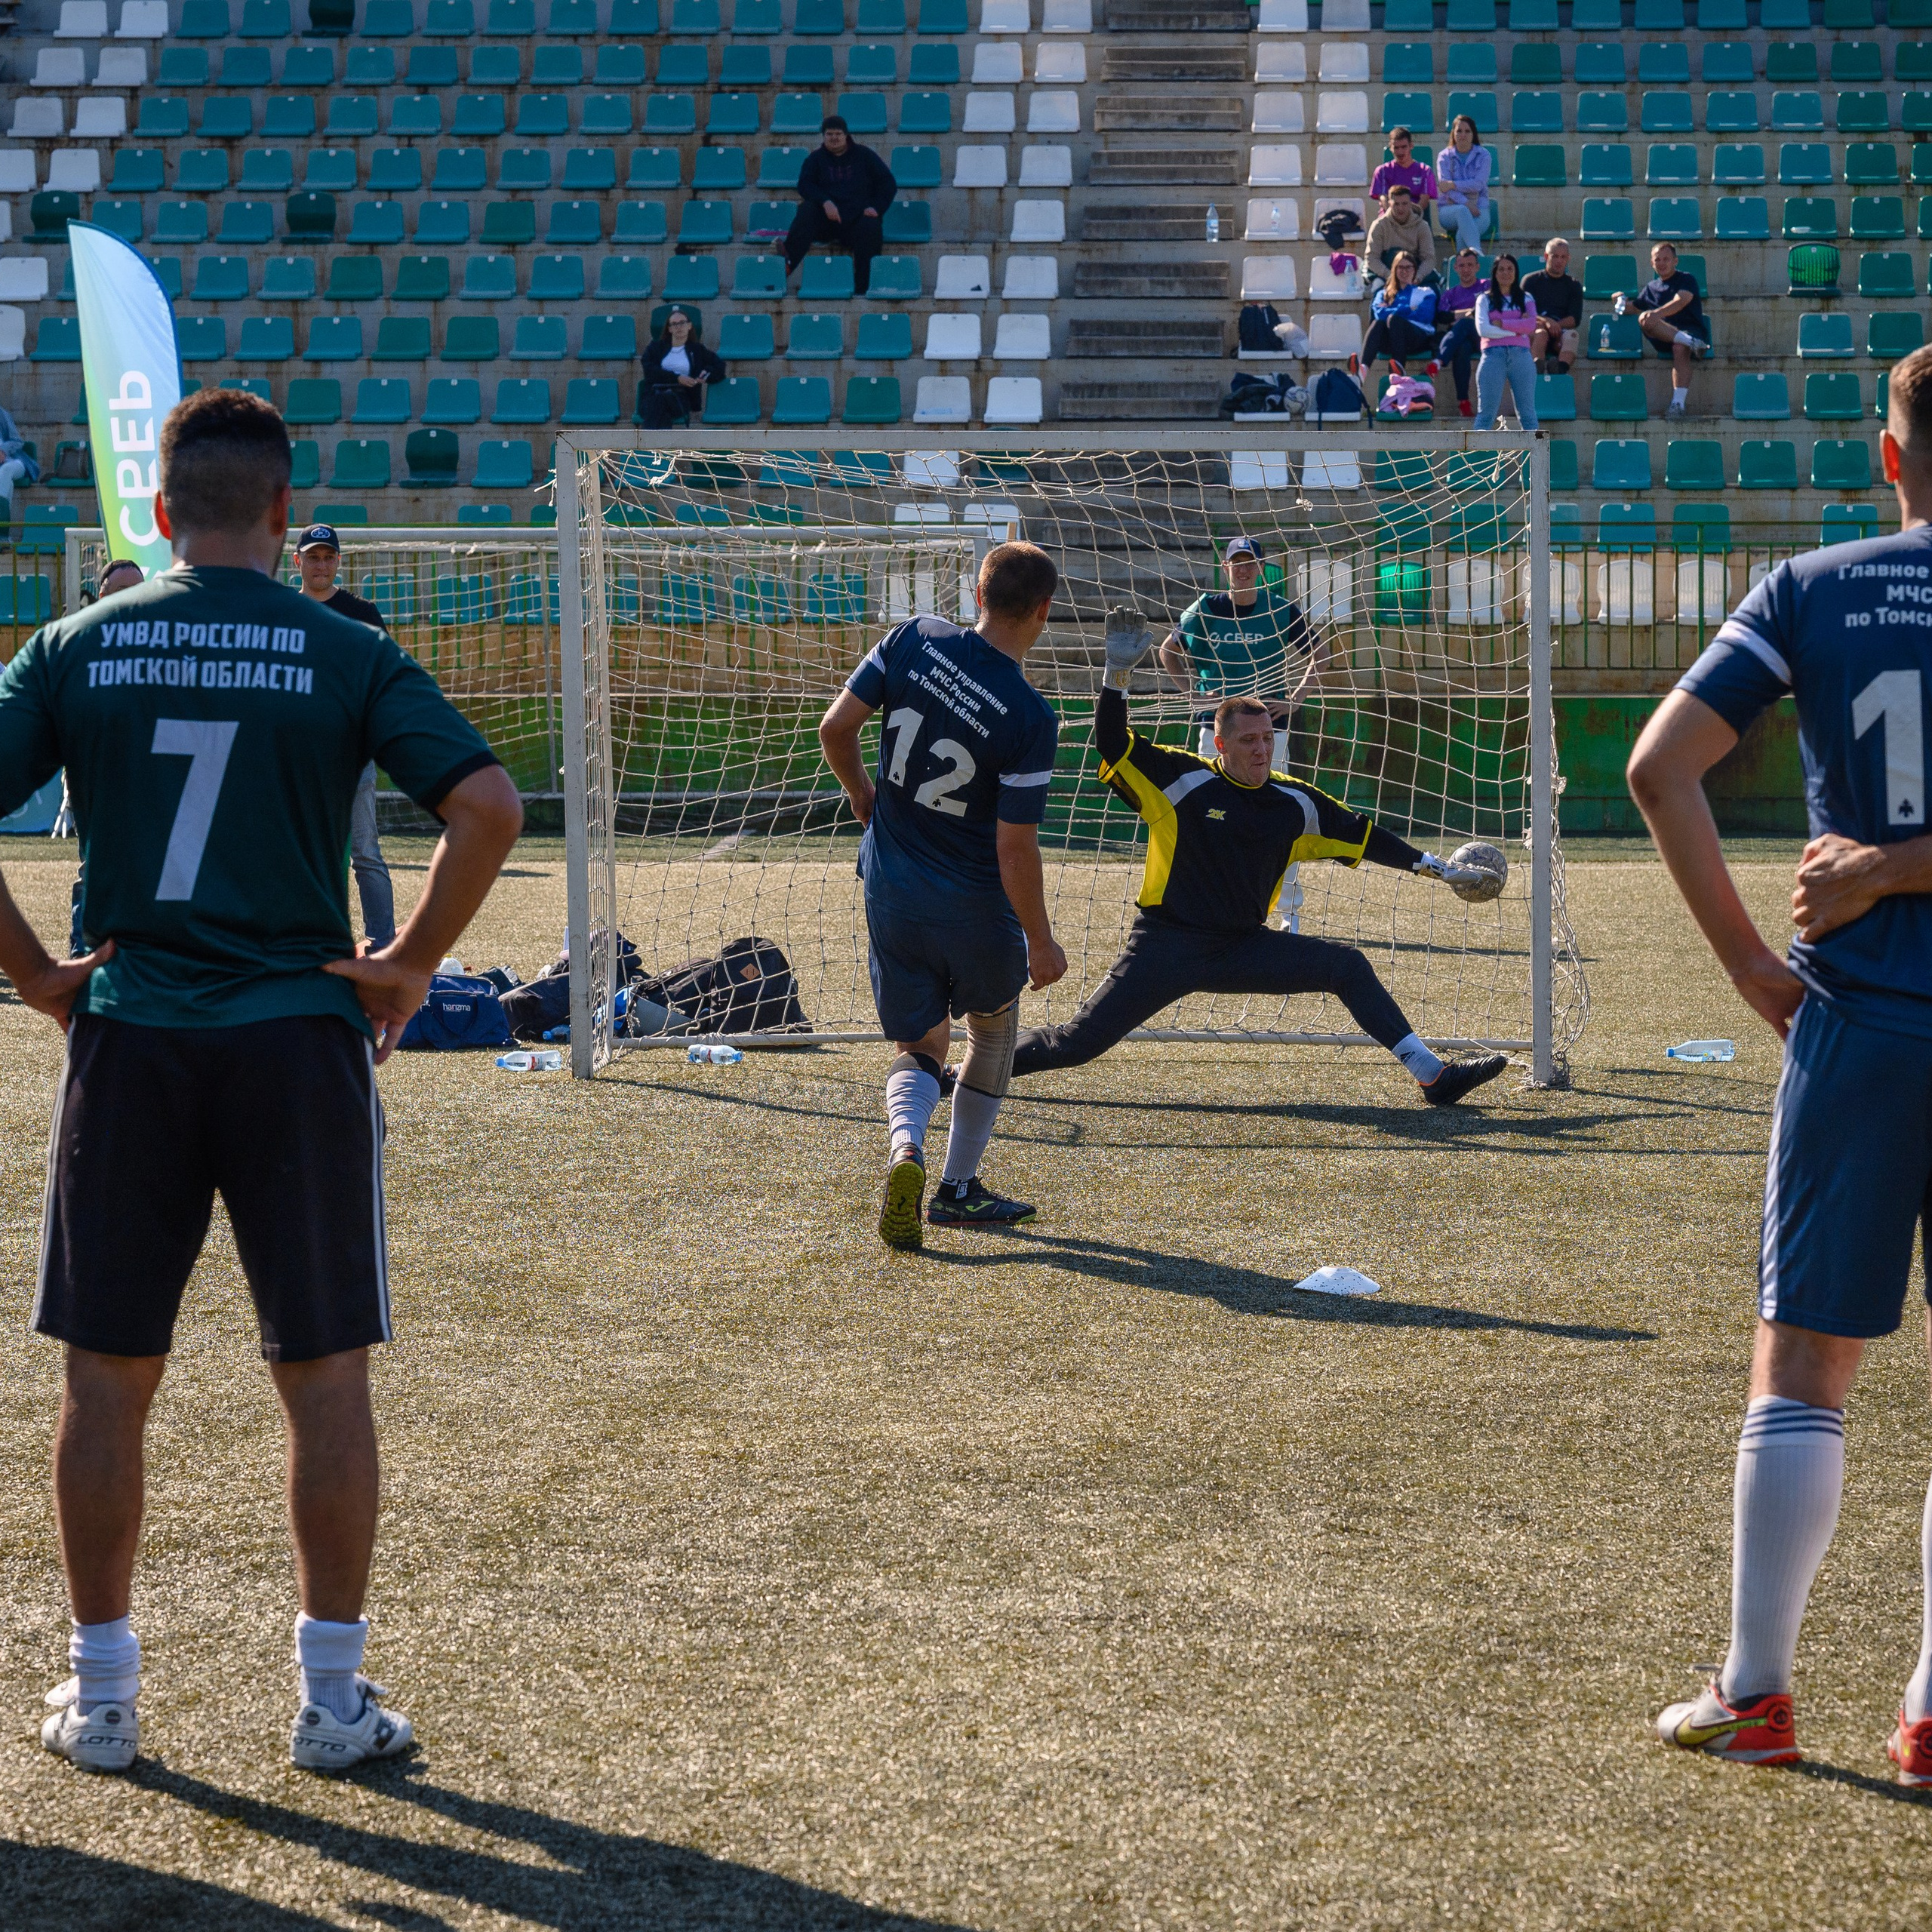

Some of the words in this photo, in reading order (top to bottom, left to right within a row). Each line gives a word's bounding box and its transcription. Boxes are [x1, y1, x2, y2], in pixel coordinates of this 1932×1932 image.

[1838, 564, 1930, 580] Главное
[1887, 584, 1932, 604] МЧС
[100, 620, 169, 649] УМВД
[174, 621, 269, 650] РОССИИ
[272, 626, 306, 654] ПО
[1845, 612, 1872, 628] по
[87, 654, 198, 688] ТОМСКОЙ
[200, 660, 314, 694] ОБЛАСТИ
[921, 641, 958, 673] Главное
[955, 669, 1008, 715] управление
[930, 666, 952, 688] МЧС
[949, 682, 982, 712] России
[907, 669, 919, 681] по
[919, 675, 955, 709] Томской
[953, 706, 990, 738] области
[887, 707, 976, 817] 12
[1851, 669, 1924, 826] 1
[150, 718, 240, 900] 7
[442, 1003, 471, 1011] harizma
[76, 1736, 137, 1748] LOTTO
[294, 1736, 347, 1752] OTTO
